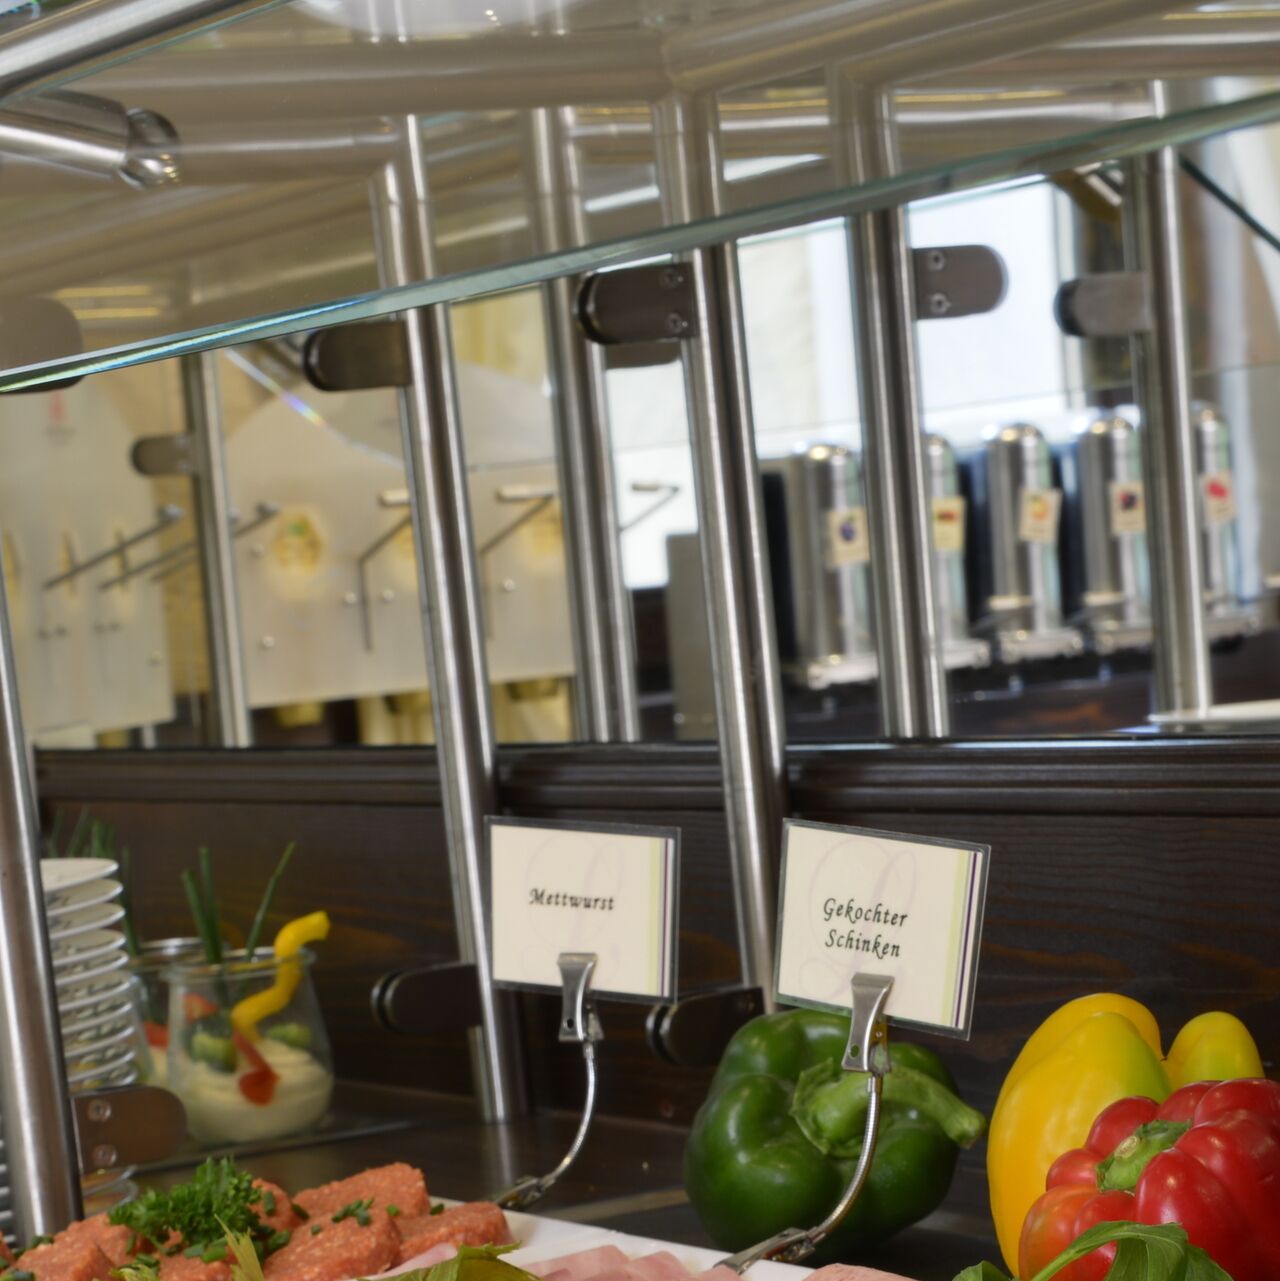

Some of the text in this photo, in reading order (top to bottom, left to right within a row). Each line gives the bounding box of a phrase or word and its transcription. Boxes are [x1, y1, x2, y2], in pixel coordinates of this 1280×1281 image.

[529, 887, 615, 911] Mettwurst
[823, 897, 909, 927] Gekochter
[825, 928, 901, 960] Schinken
